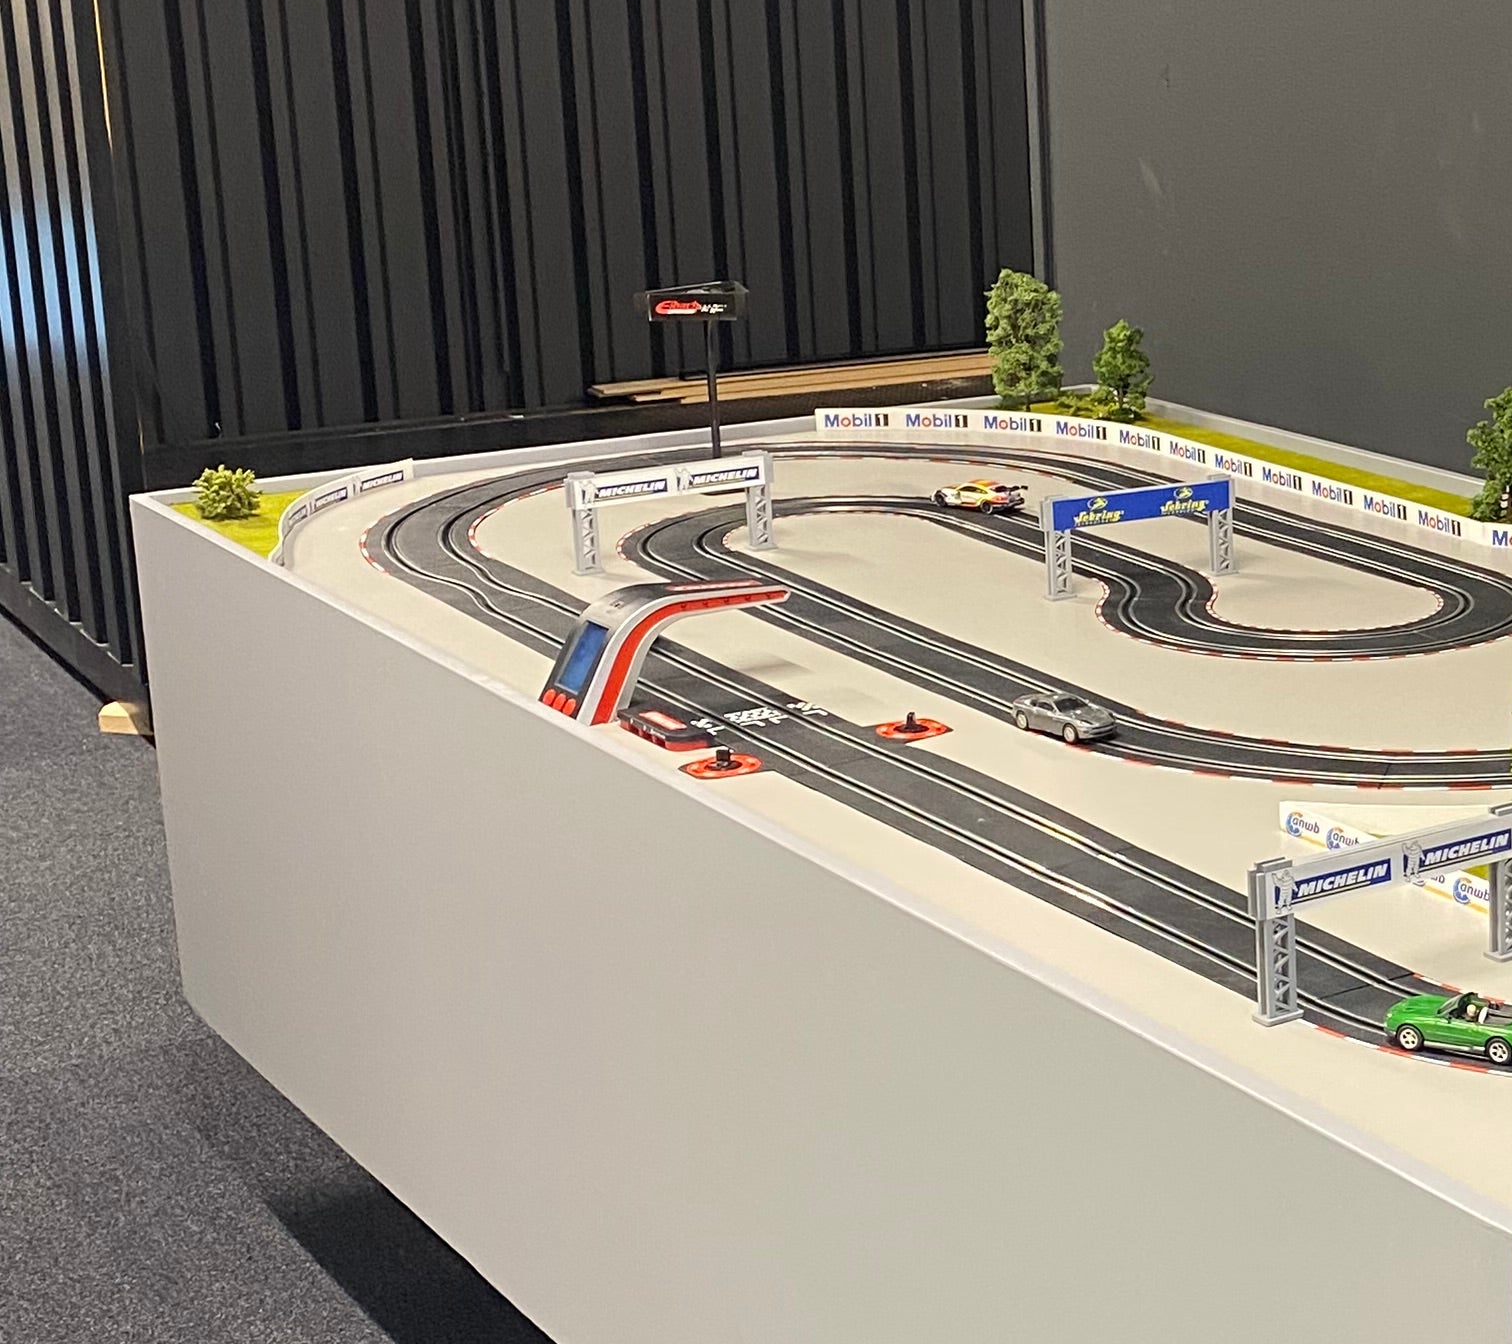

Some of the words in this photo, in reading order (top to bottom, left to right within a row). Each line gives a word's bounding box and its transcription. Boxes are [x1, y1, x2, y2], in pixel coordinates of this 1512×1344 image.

[693, 467, 758, 485] MICHELIN
[598, 479, 666, 498] MICHELIN
[1292, 817, 1320, 834] anwb
[1424, 833, 1509, 865] MICHELIN
[1297, 863, 1389, 897] MICHELIN
